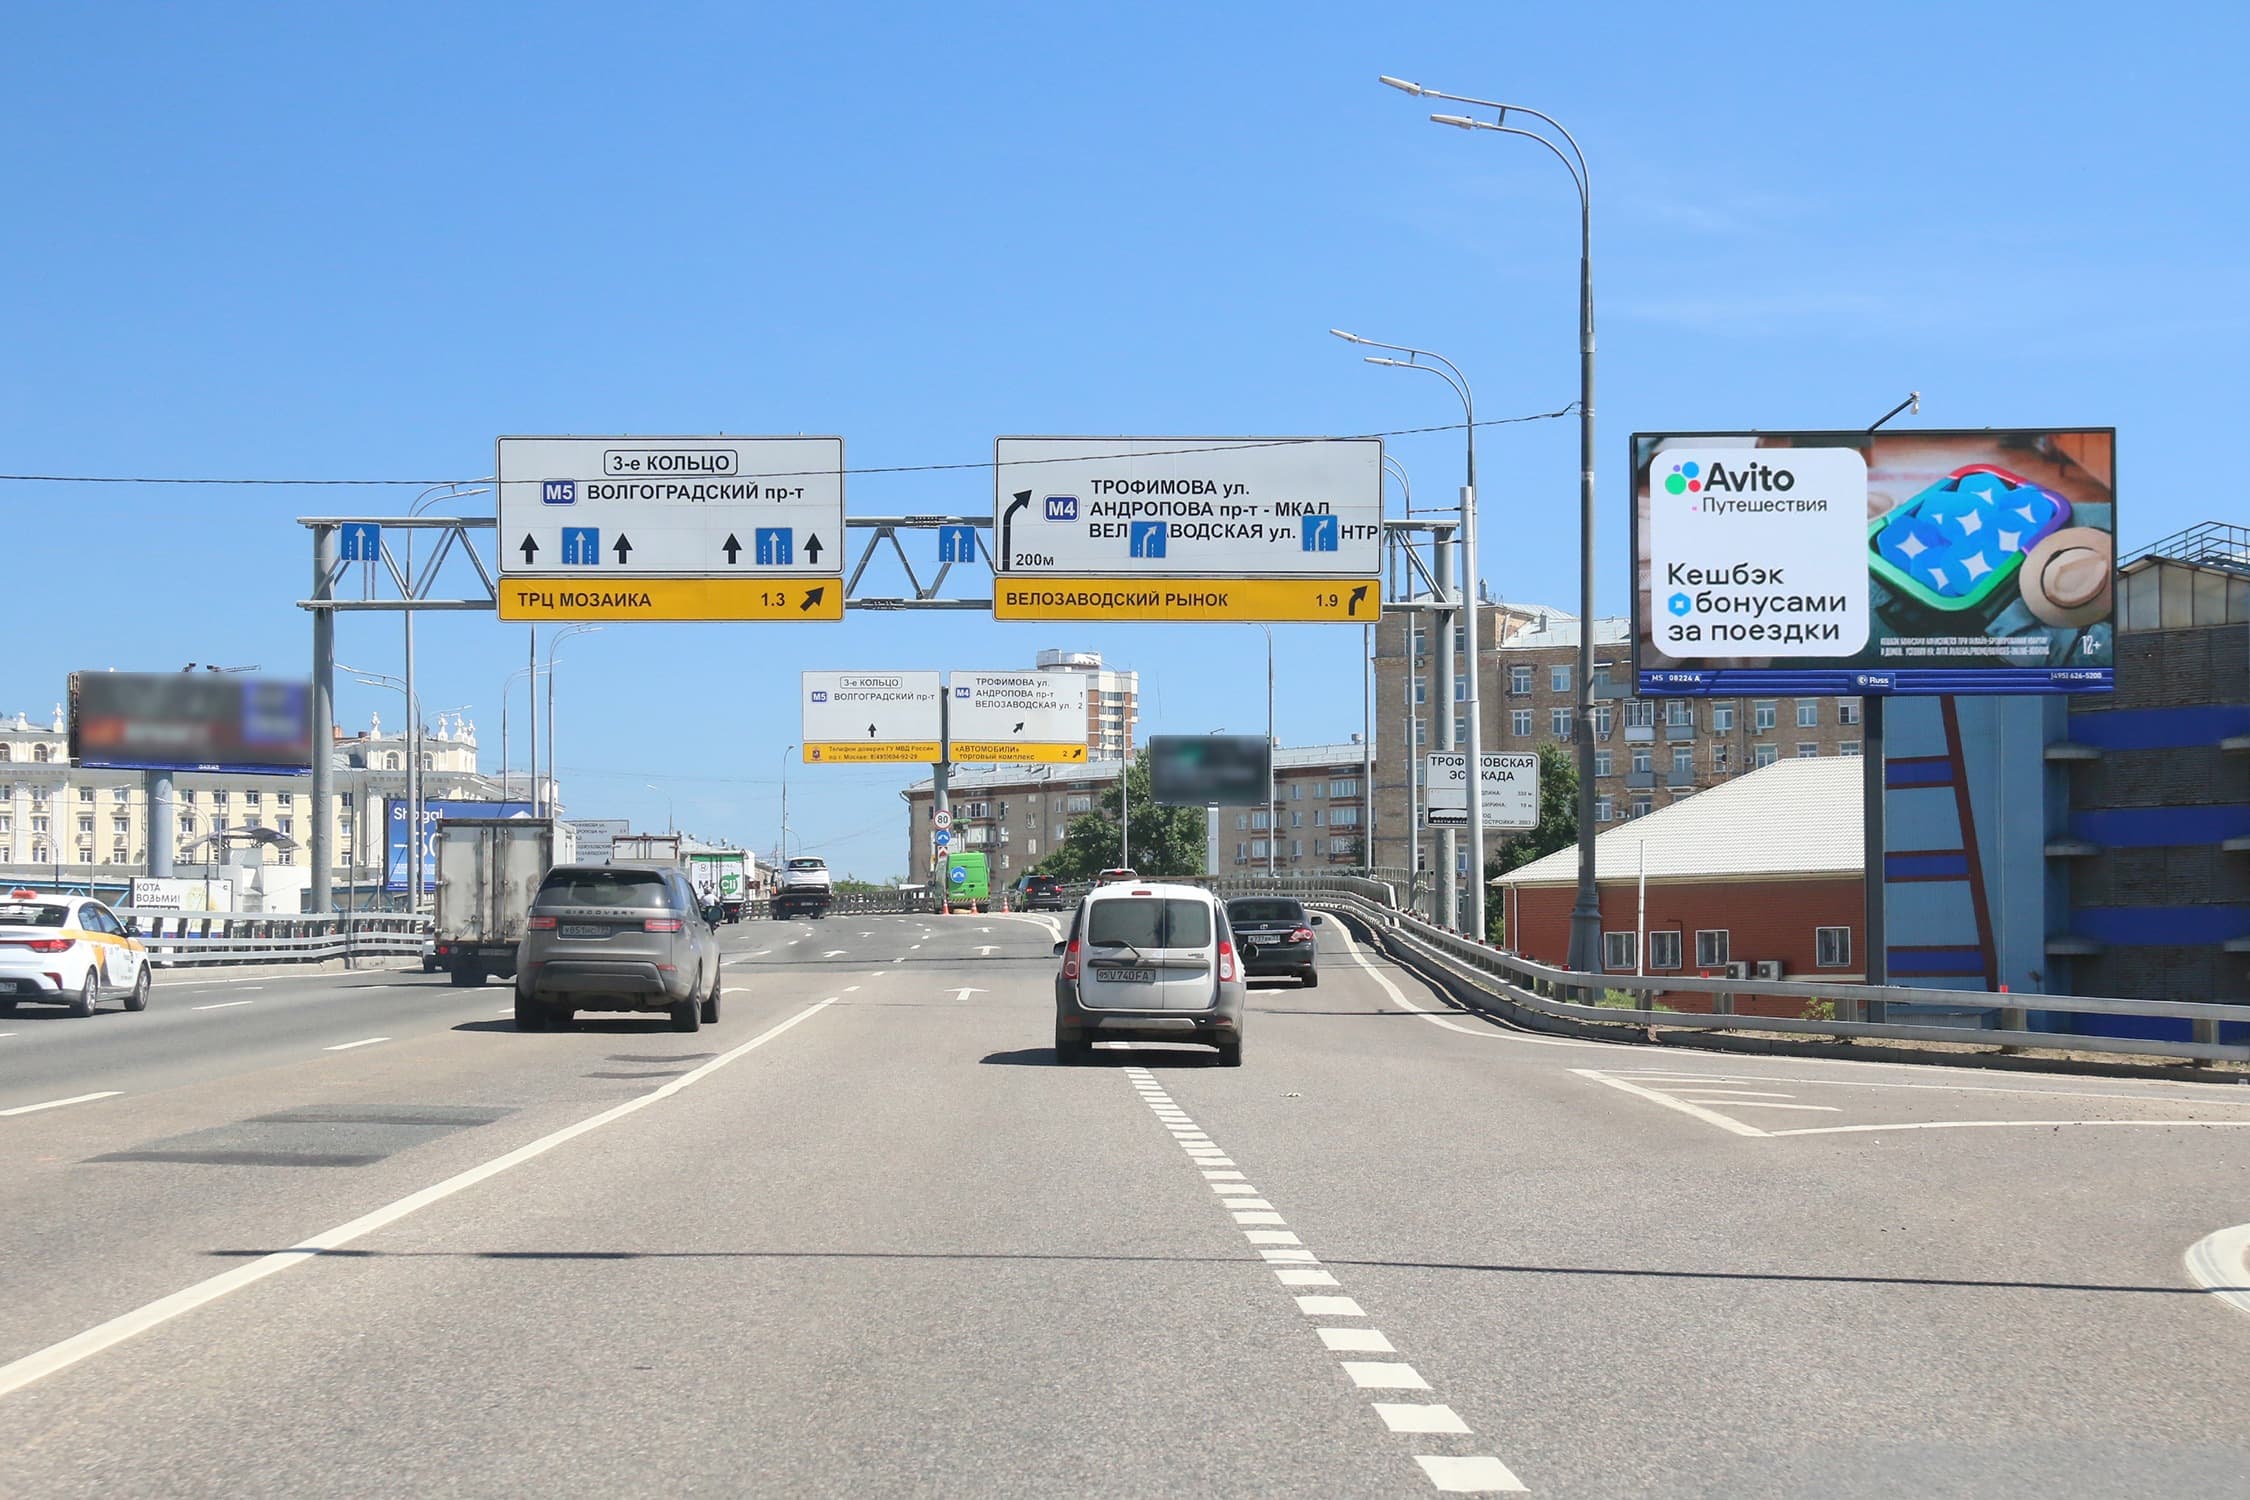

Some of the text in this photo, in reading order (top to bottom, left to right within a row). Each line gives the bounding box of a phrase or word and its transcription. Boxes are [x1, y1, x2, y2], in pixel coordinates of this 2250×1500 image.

[613, 456, 730, 474] 3-е КОЛЬЦО
[1703, 461, 1795, 493] Avito
[546, 484, 573, 500] М5
[587, 481, 804, 502] ВОЛГОГРАДСКИЙ пр-т
[1090, 479, 1250, 499] ТРОФИМОВА ул.
[1048, 501, 1076, 517] М4
[1090, 501, 1214, 519] АНДРОПОВА
[1219, 504, 1258, 521] пр-т
[1702, 497, 1828, 514] Путешествия
[1089, 523, 1263, 541] ВЕЛВОДСКАЯ
[1269, 525, 1297, 543] ул.
[1015, 553, 1054, 567] 200м
[1667, 562, 1785, 586] Кешбэк
[518, 592, 786, 610] ТРЦ МОЗАИКА 1.3
[1006, 590, 1338, 608] ВЕЛОЗАВОДСКИЙ РЫНОК 1.9
[1696, 590, 1847, 619] бонусами
[1667, 622, 1840, 647] за поездки
[2082, 635, 2102, 656] 12+
[843, 679, 899, 688] 3-е КОЛЬЦО
[976, 678, 1050, 689] ТРОФИМОВА ул.
[1869, 676, 1889, 685] Russ
[834, 691, 935, 703] ВОЛГОГРАДСКИЙ пр-т
[976, 689, 1034, 699] АНДРОПОВА
[1036, 691, 1054, 700] пр-т
[975, 700, 1083, 711] ВЕЛОЗАВОДСКАЯ ул. 2
[959, 753, 1035, 761] торговый комплекс
[1430, 756, 1534, 769] ТРОФОВСКАЯ
[1449, 770, 1515, 782] ЭСКАДА
[937, 815, 949, 824] 80
[136, 883, 161, 891] КОТА
[136, 894, 180, 903] ВОЗЬМИ!
